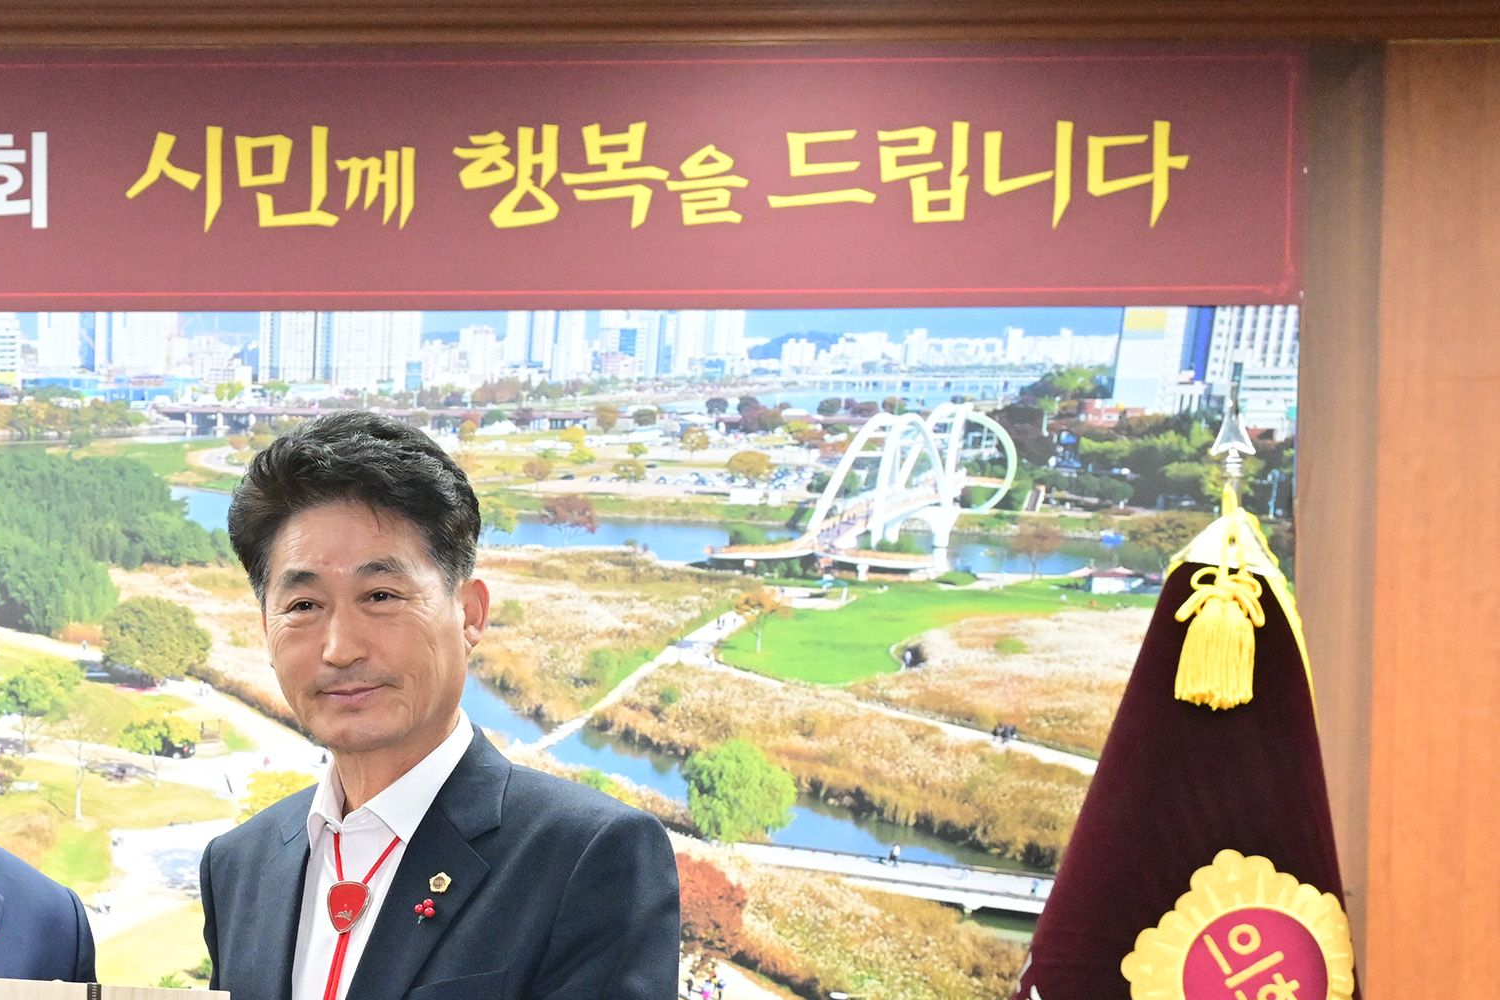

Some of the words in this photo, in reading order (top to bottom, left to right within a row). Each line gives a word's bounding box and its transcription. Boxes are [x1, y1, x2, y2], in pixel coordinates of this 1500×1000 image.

[125, 125, 416, 232] 시민께
[452, 121, 750, 229] 행복을
[766, 120, 1190, 229] 드립니다
